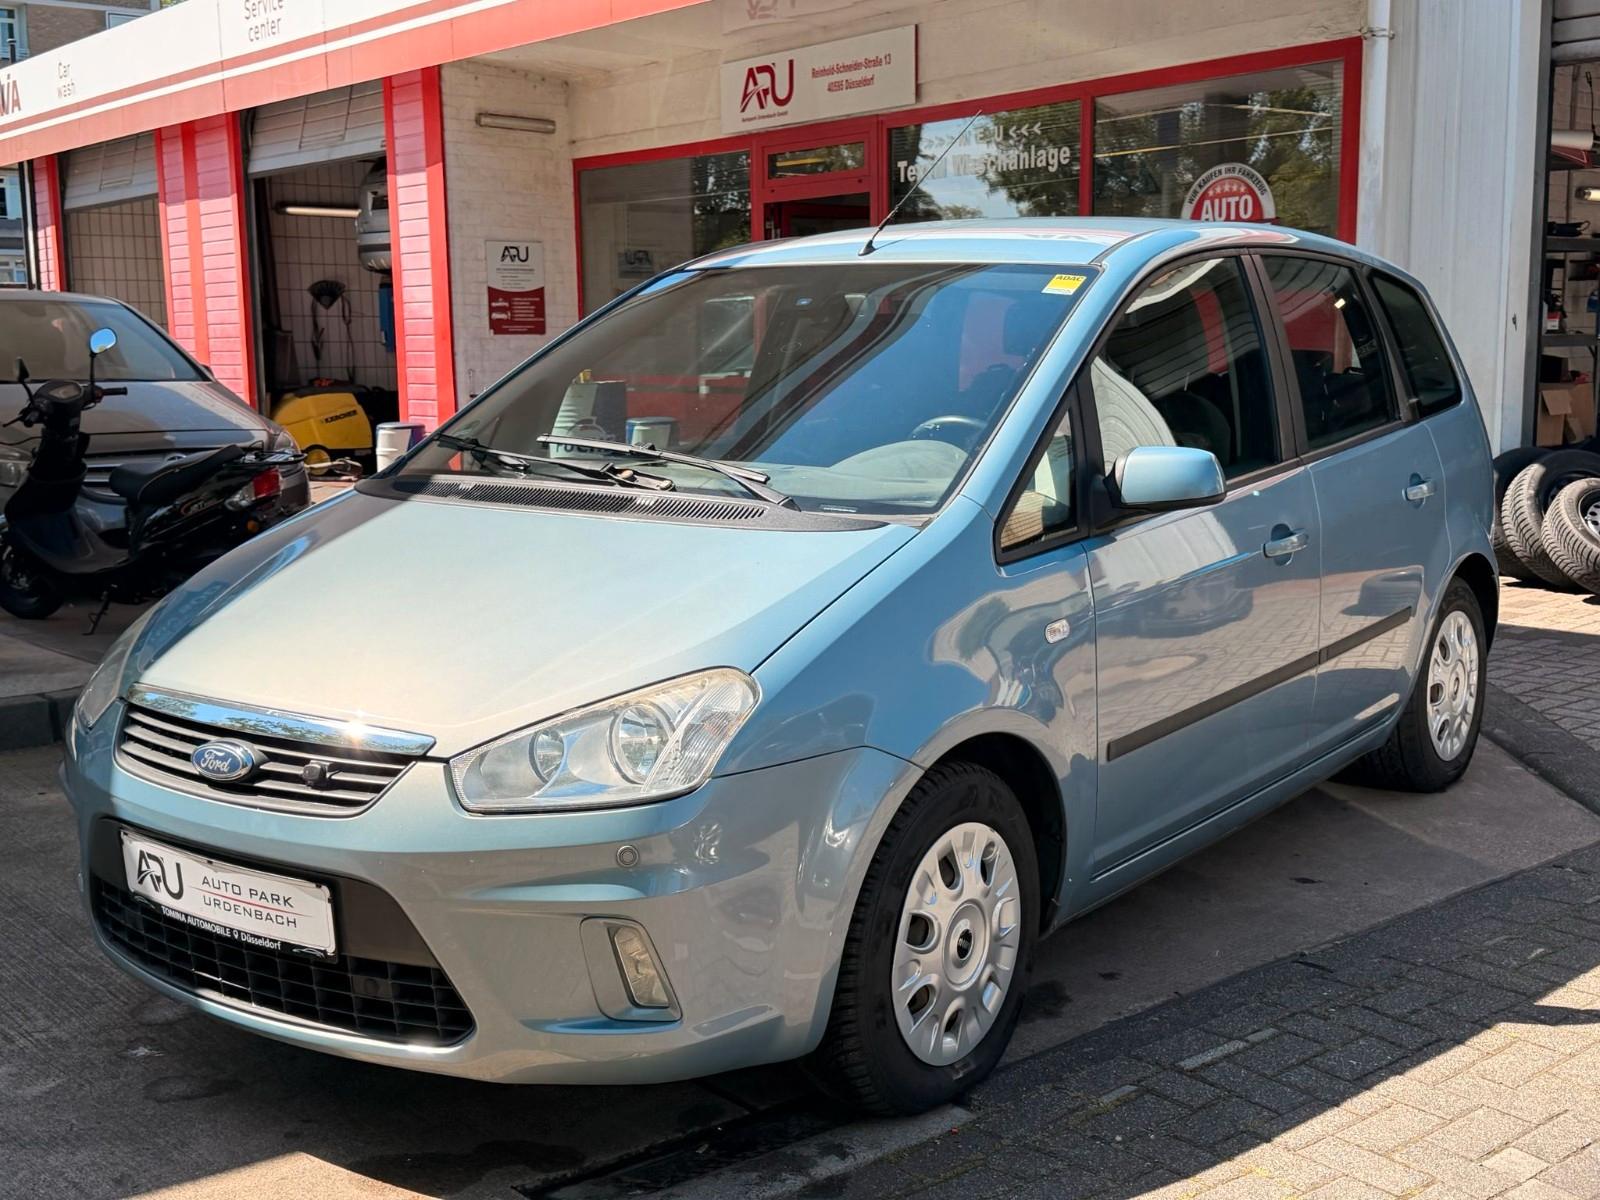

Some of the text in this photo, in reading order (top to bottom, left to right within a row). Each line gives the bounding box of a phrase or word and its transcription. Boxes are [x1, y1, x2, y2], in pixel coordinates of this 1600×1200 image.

[244, 0, 284, 20] Service
[248, 17, 282, 42] center
[58, 62, 71, 79] Car
[952, 145, 1071, 177] Waschanlage
[1199, 168, 1223, 189] KAUFEN
[1201, 194, 1253, 222] AUTO
[200, 749, 232, 774] Ford
[201, 875, 295, 909] AUTO PARK
[203, 894, 298, 929] URDENBACH
[161, 905, 282, 951] TOMINA AUTOMOBILE Düsseldorf
